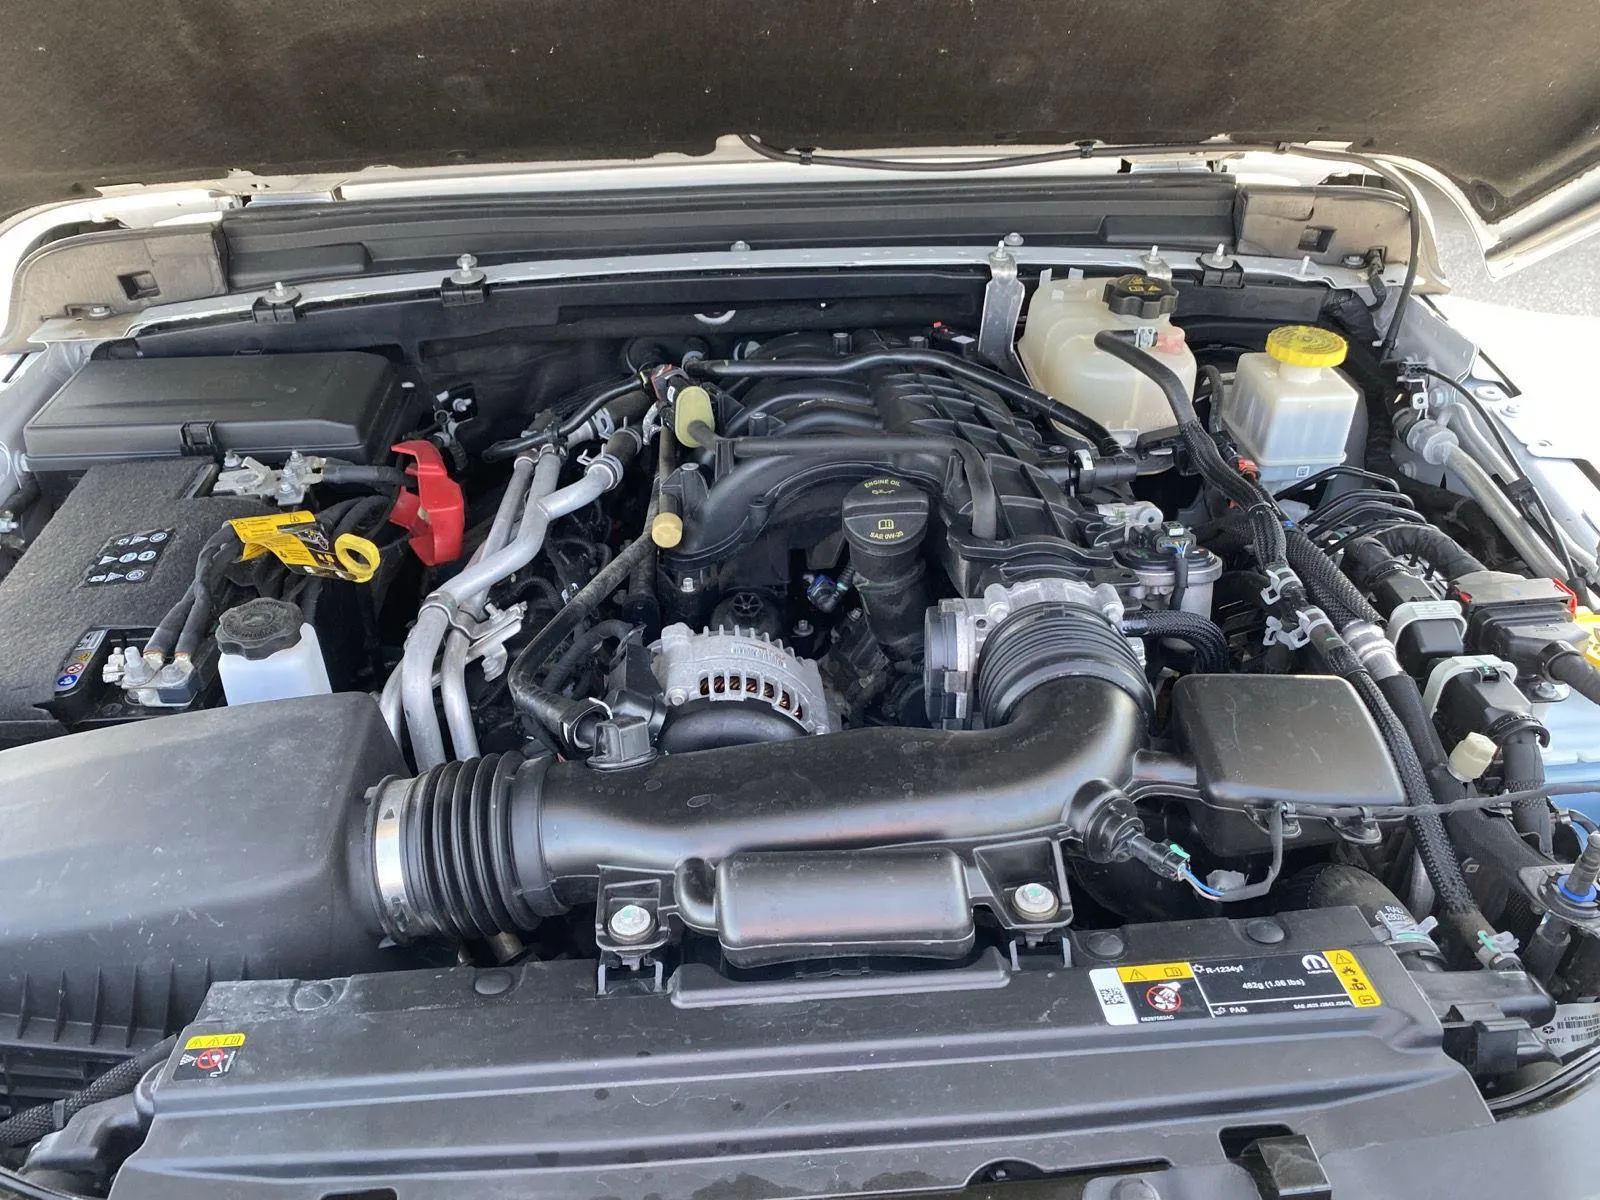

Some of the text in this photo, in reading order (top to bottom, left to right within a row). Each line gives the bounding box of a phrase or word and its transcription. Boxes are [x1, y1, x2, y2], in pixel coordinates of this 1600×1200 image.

[864, 479, 902, 489] ENGINE OIL
[1205, 964, 1244, 974] R-1234yf
[1242, 982, 1264, 990] 482g
[1286, 978, 1306, 987] lbs)
